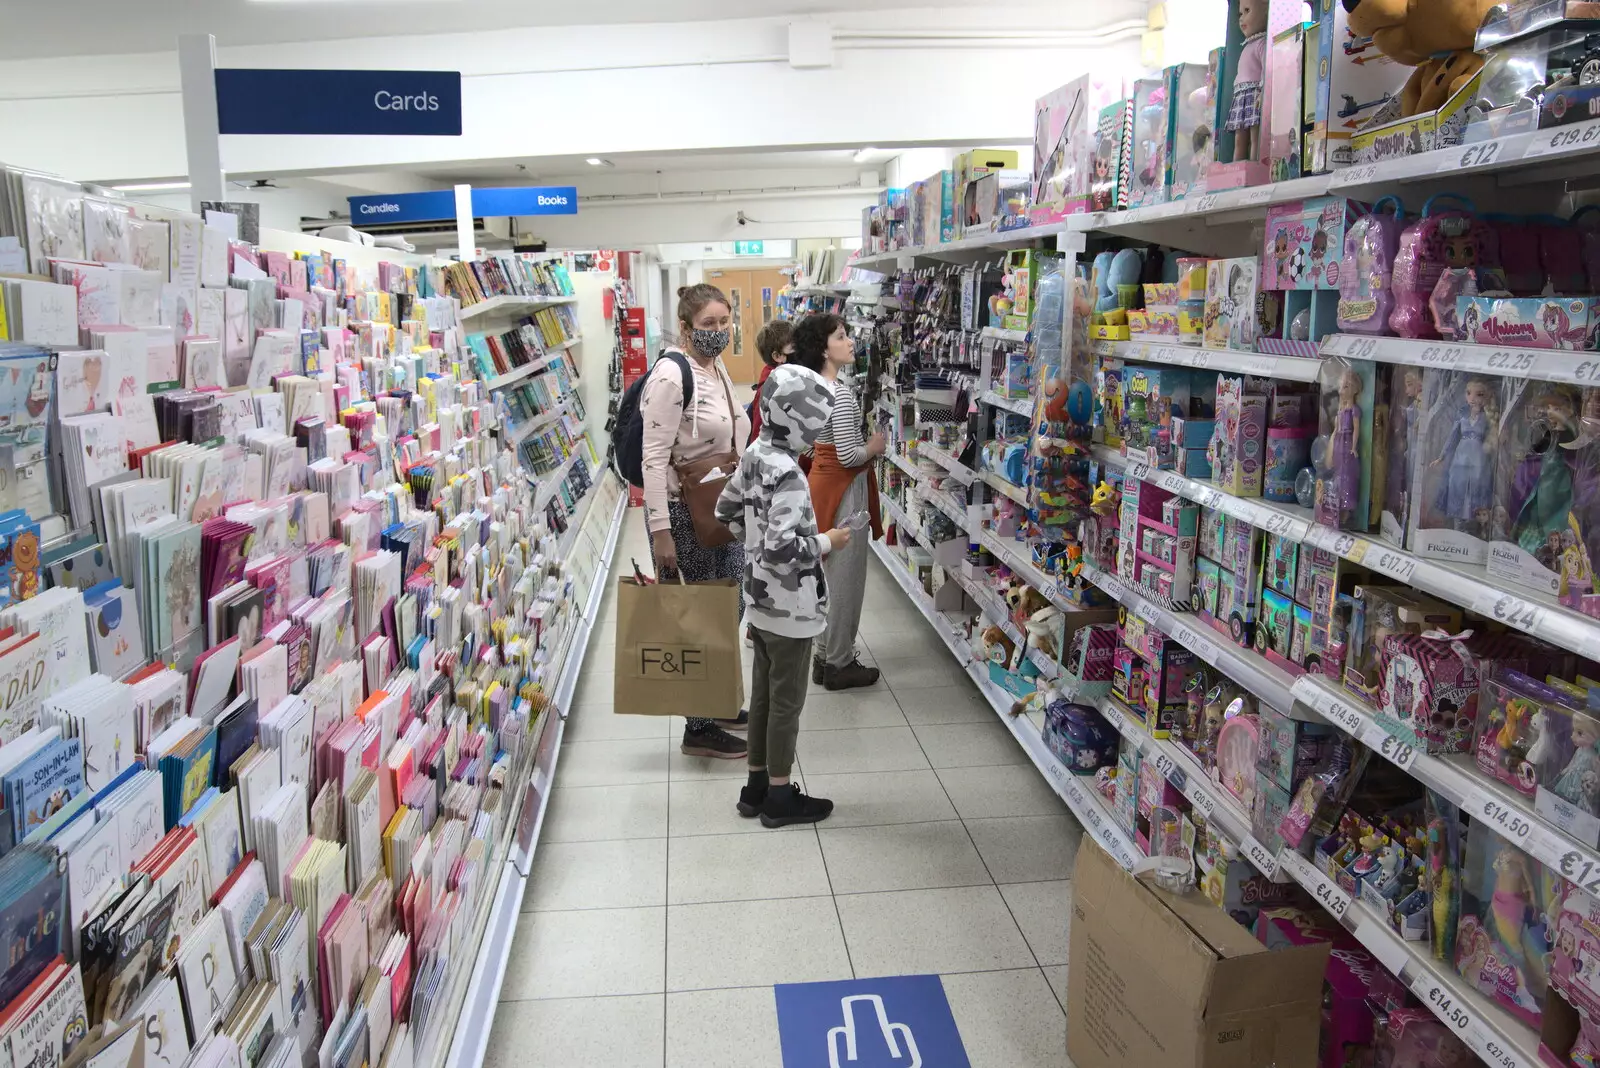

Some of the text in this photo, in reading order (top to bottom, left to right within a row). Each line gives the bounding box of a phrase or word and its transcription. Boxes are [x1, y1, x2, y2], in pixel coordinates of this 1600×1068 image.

[374, 90, 440, 112] Cards
[1460, 142, 1498, 167] €12
[360, 203, 399, 214] Candles
[538, 195, 568, 206] Books
[1346, 339, 1377, 357] €18
[1420, 346, 1460, 364] €8.82
[1487, 352, 1534, 371] €2.25
[1133, 463, 1149, 479] €18
[1266, 514, 1293, 535] €24
[1334, 534, 1355, 554] €9
[1427, 543, 1469, 556] FROZEN II
[1492, 547, 1515, 561] FROZEN
[1379, 553, 1415, 576] €17.71
[1493, 594, 1538, 629] €24
[1179, 629, 1198, 649] €17.71
[641, 648, 701, 675] F&F
[6, 660, 45, 711] DAD
[1329, 703, 1360, 729] €14.99
[1381, 735, 1413, 765] €18
[1479, 735, 1497, 756] Barbie
[34, 741, 79, 786] SON-IN-LAW
[1156, 755, 1172, 777] €12
[1193, 788, 1213, 812] €20.50
[1483, 801, 1530, 838] €14.50
[1250, 846, 1275, 873] €22.36
[177, 858, 199, 909] DAD
[1316, 883, 1347, 914] €4.25
[121, 914, 150, 957] SON
[1484, 954, 1516, 986] Barbie
[20, 1009, 45, 1039] HAPPY
[46, 974, 76, 1011] BIRTHDAY
[1429, 987, 1469, 1029] €14.50
[1486, 1041, 1516, 1068] €27.50
